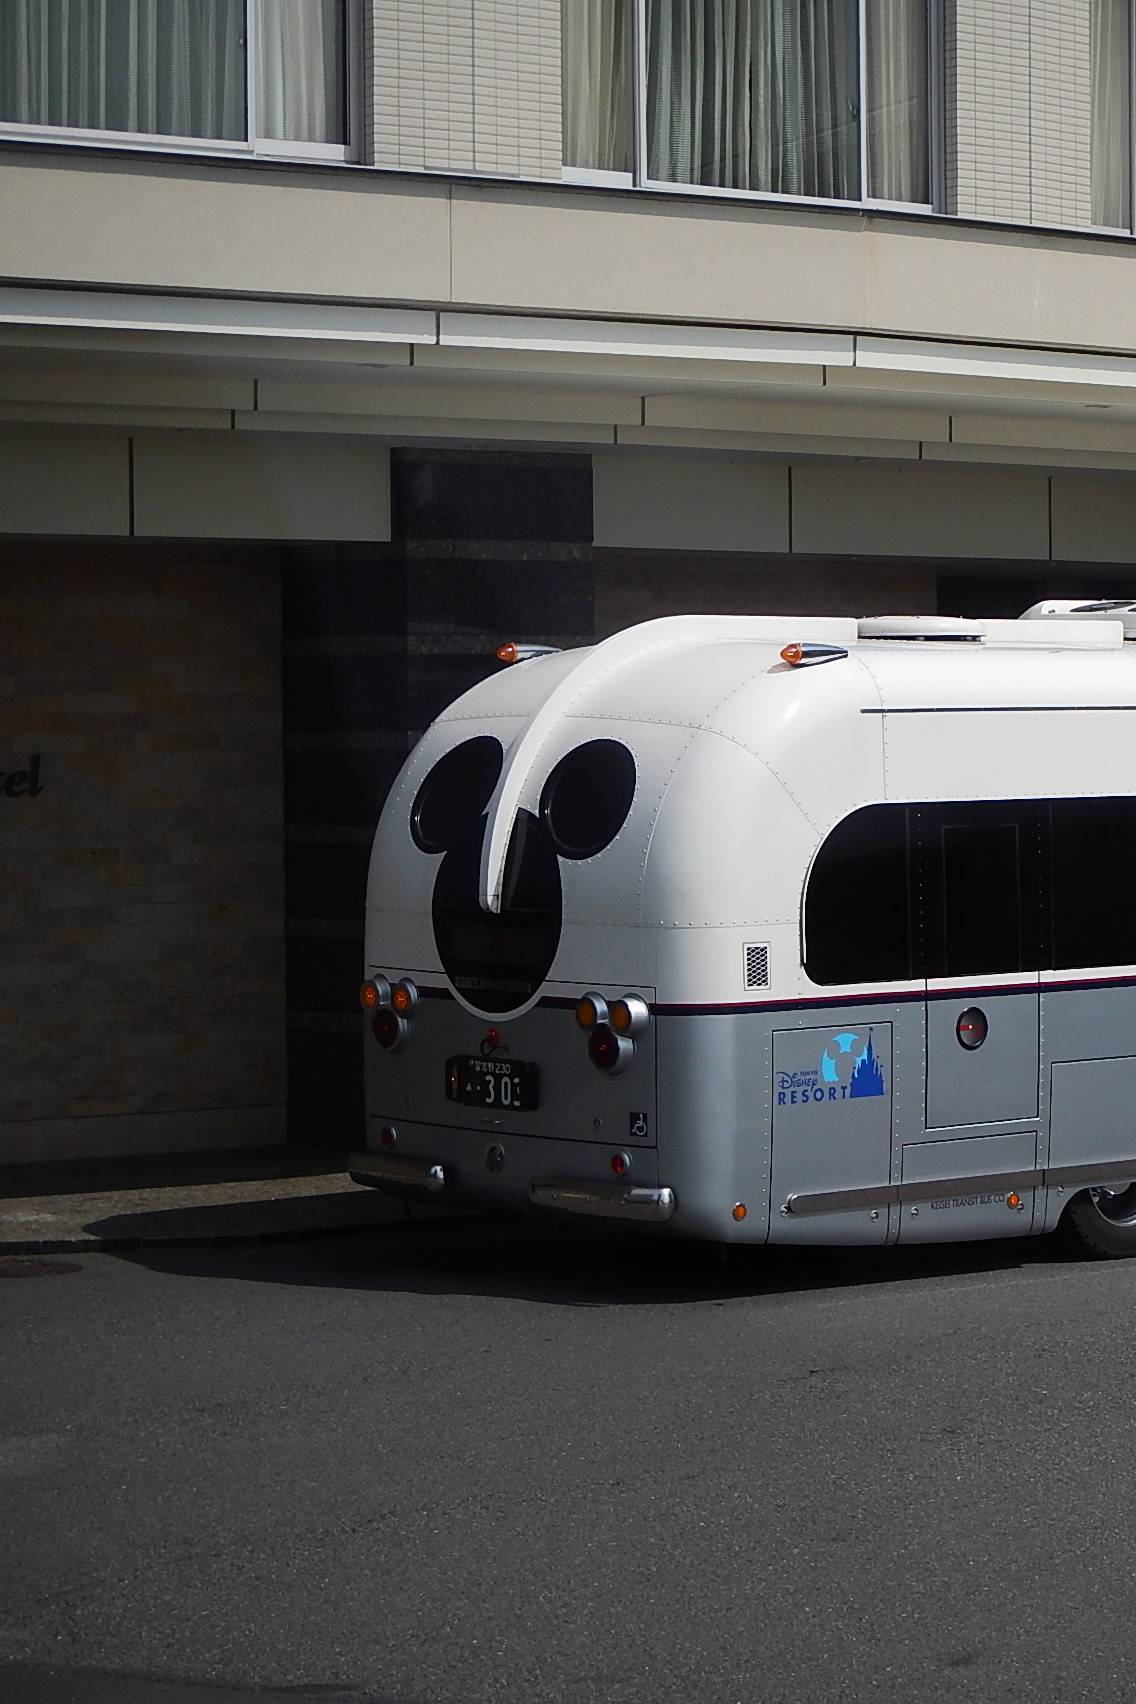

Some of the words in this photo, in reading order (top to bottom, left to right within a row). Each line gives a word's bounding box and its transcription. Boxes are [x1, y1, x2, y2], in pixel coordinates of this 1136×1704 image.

[495, 1062, 511, 1074] 230
[777, 1086, 848, 1105] RESORT
[931, 1200, 952, 1210] KEISEI
[952, 1196, 979, 1208] TRANSIT
[979, 1195, 992, 1205] BUS
